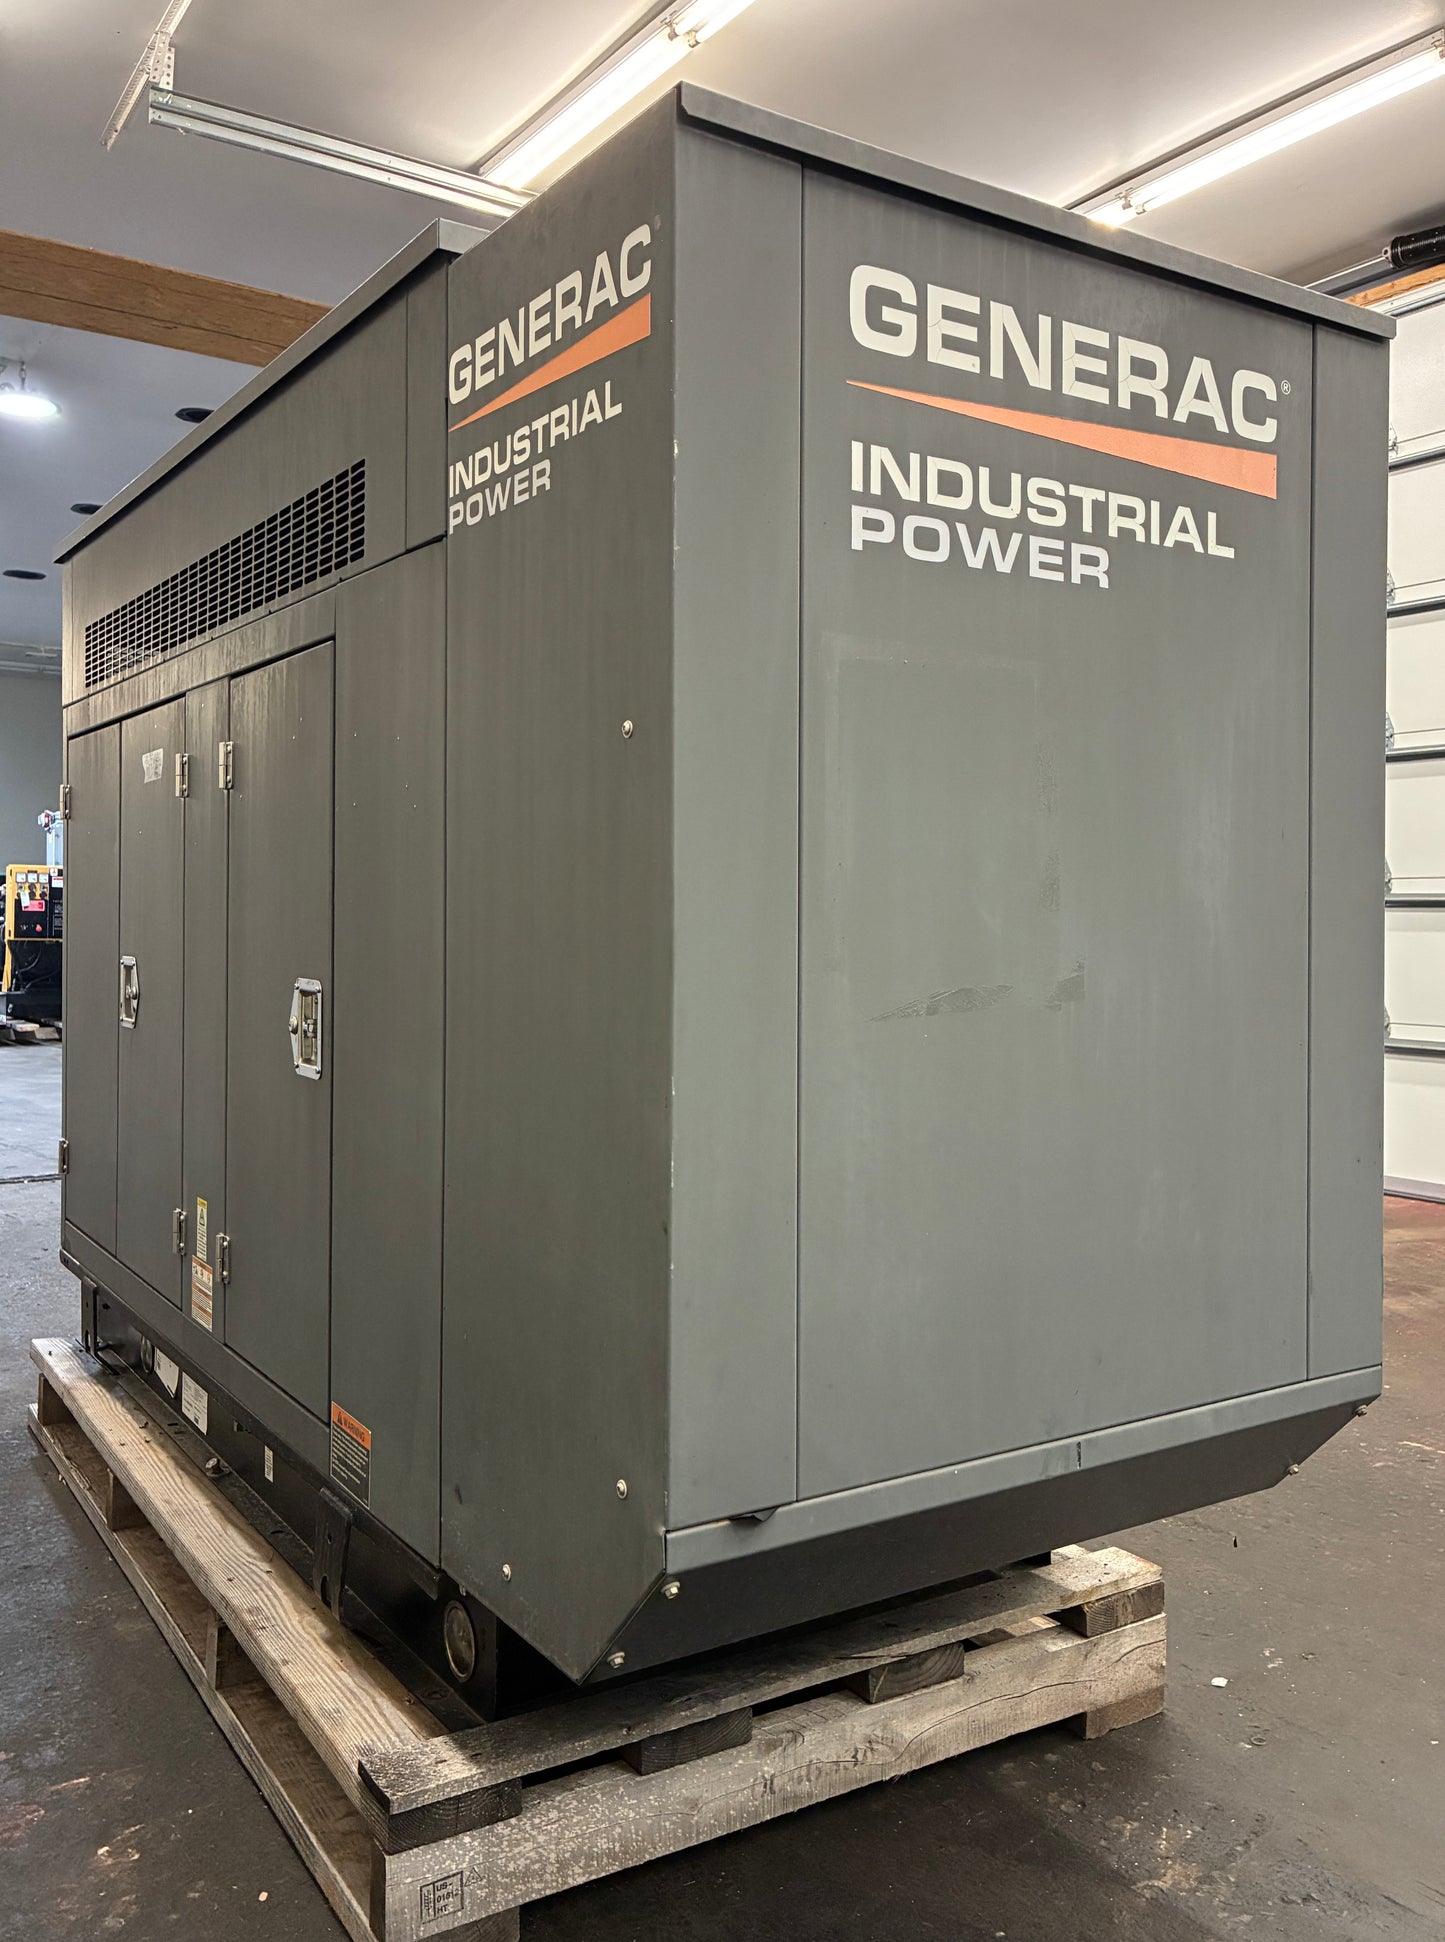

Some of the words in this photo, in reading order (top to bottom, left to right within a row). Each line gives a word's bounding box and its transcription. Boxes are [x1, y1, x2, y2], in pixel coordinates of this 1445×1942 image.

[448, 223, 652, 406] GENERAC
[449, 380, 623, 499] INDUSTRIAL
[448, 458, 552, 536] POWER
[850, 440, 1236, 560] INDUSTRIAL
[850, 503, 1110, 590] POWER
[343, 1416, 365, 1442] WARNING
